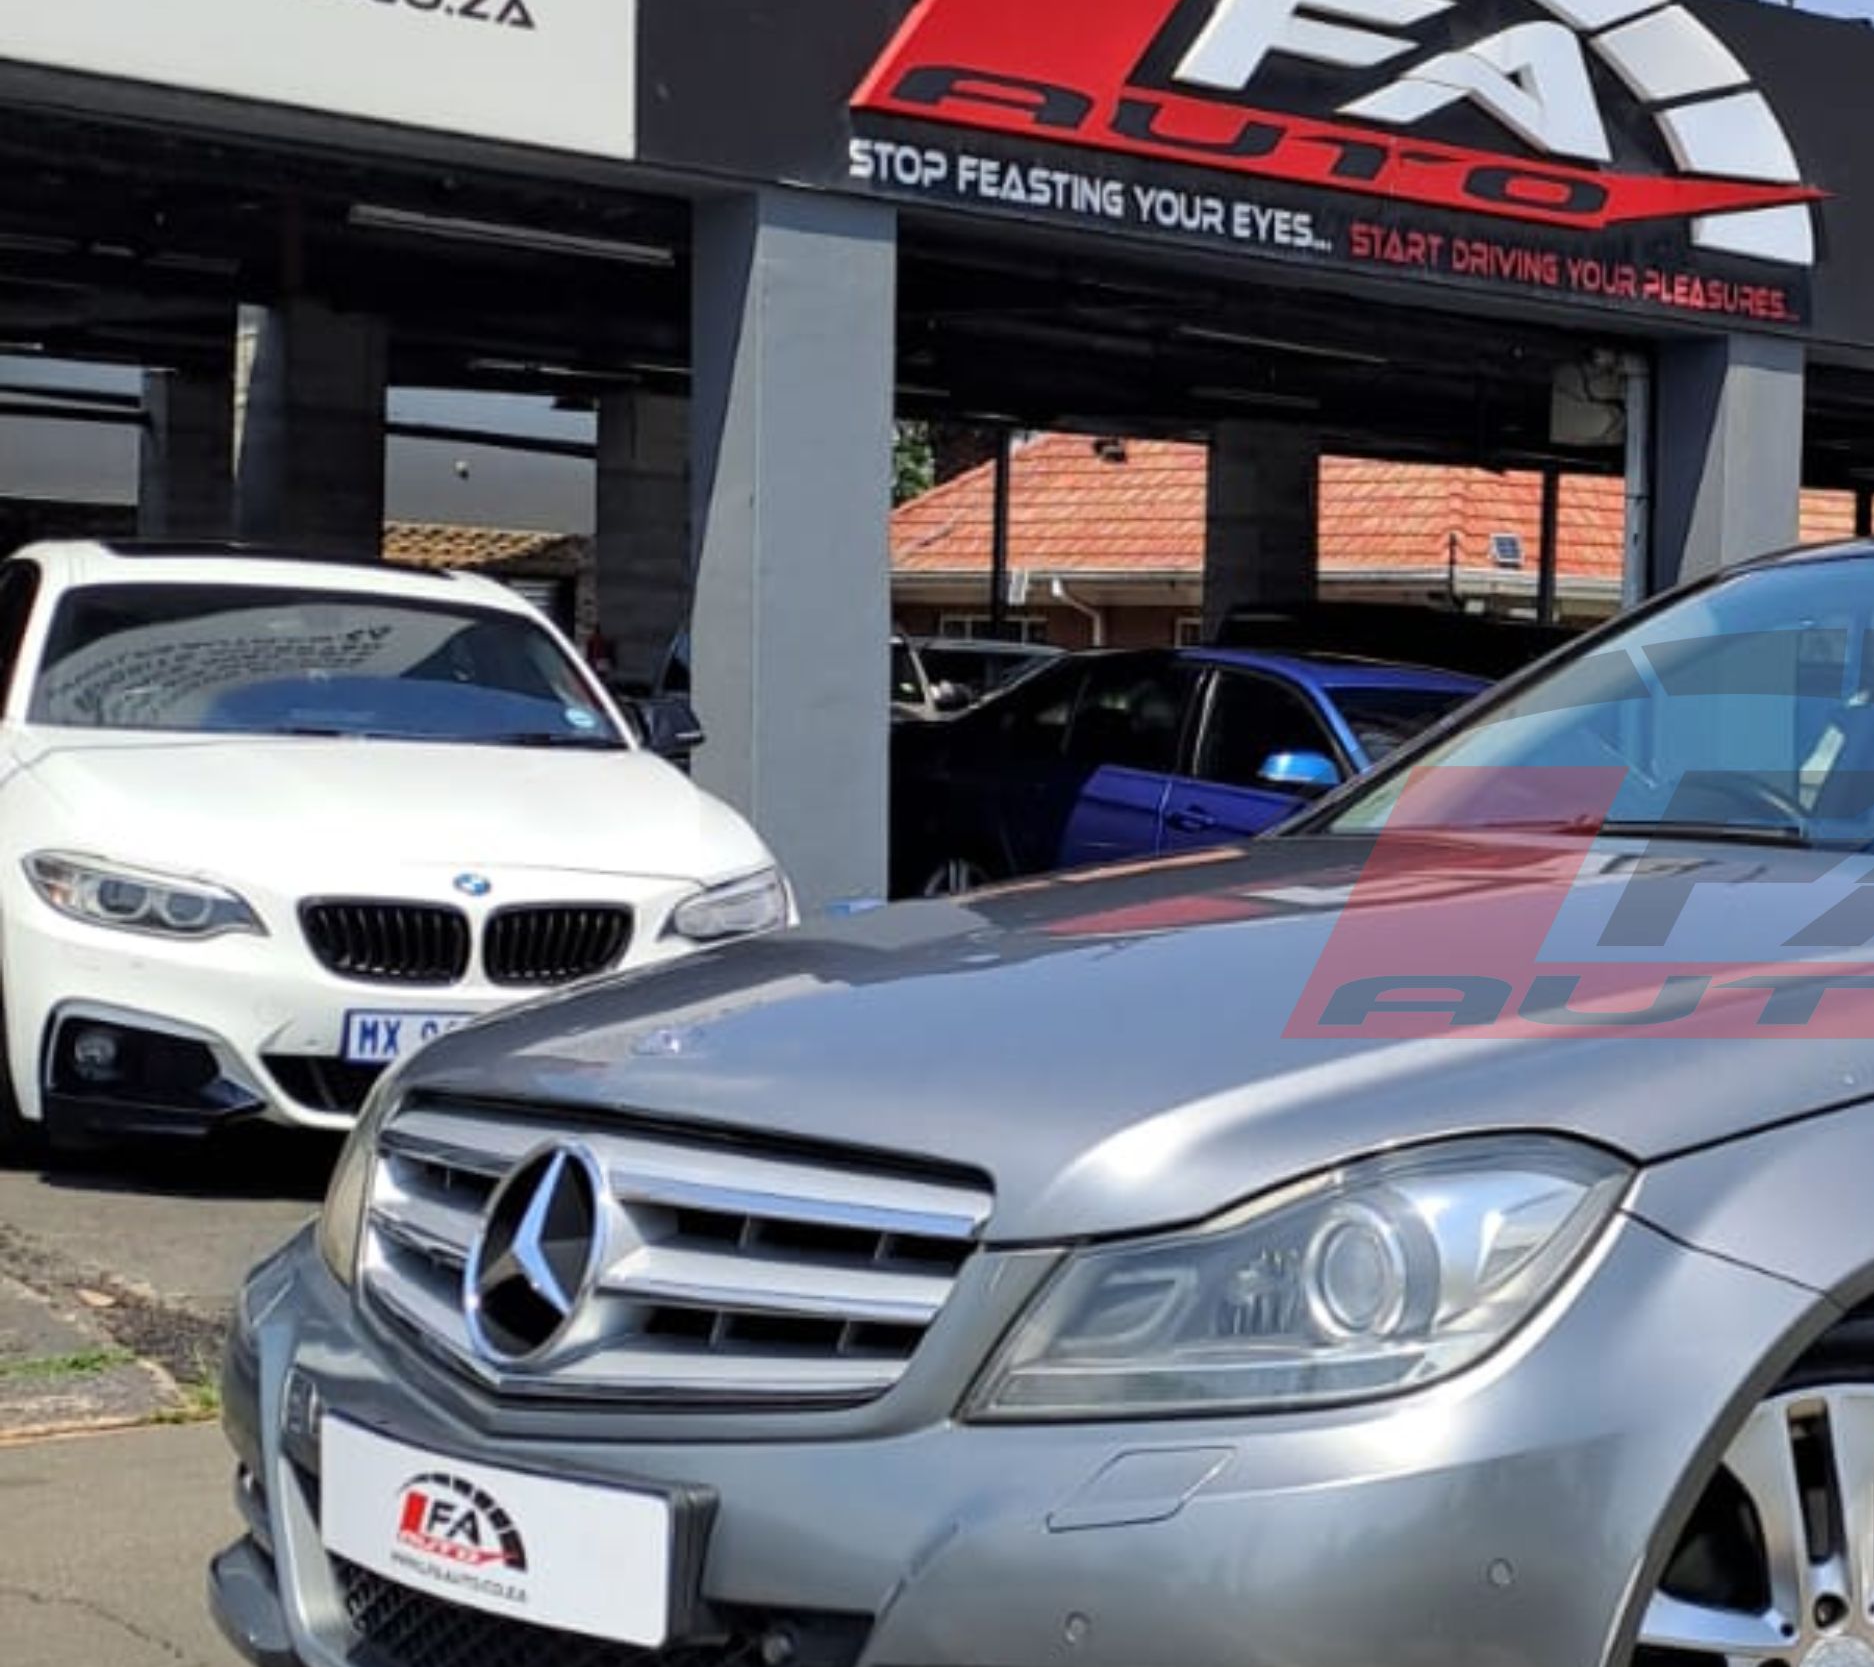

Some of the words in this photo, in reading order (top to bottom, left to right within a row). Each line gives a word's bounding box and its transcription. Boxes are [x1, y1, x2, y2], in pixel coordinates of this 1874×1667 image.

[848, 138, 948, 187] STOP
[957, 153, 1125, 218] FEASTING
[1133, 184, 1224, 235] YOUR
[1232, 203, 1333, 252] EYES...
[891, 66, 1610, 214] AUTO
[1350, 222, 1443, 264] START
[1451, 238, 1559, 286] DRIVING
[1566, 257, 1637, 298] YOUR
